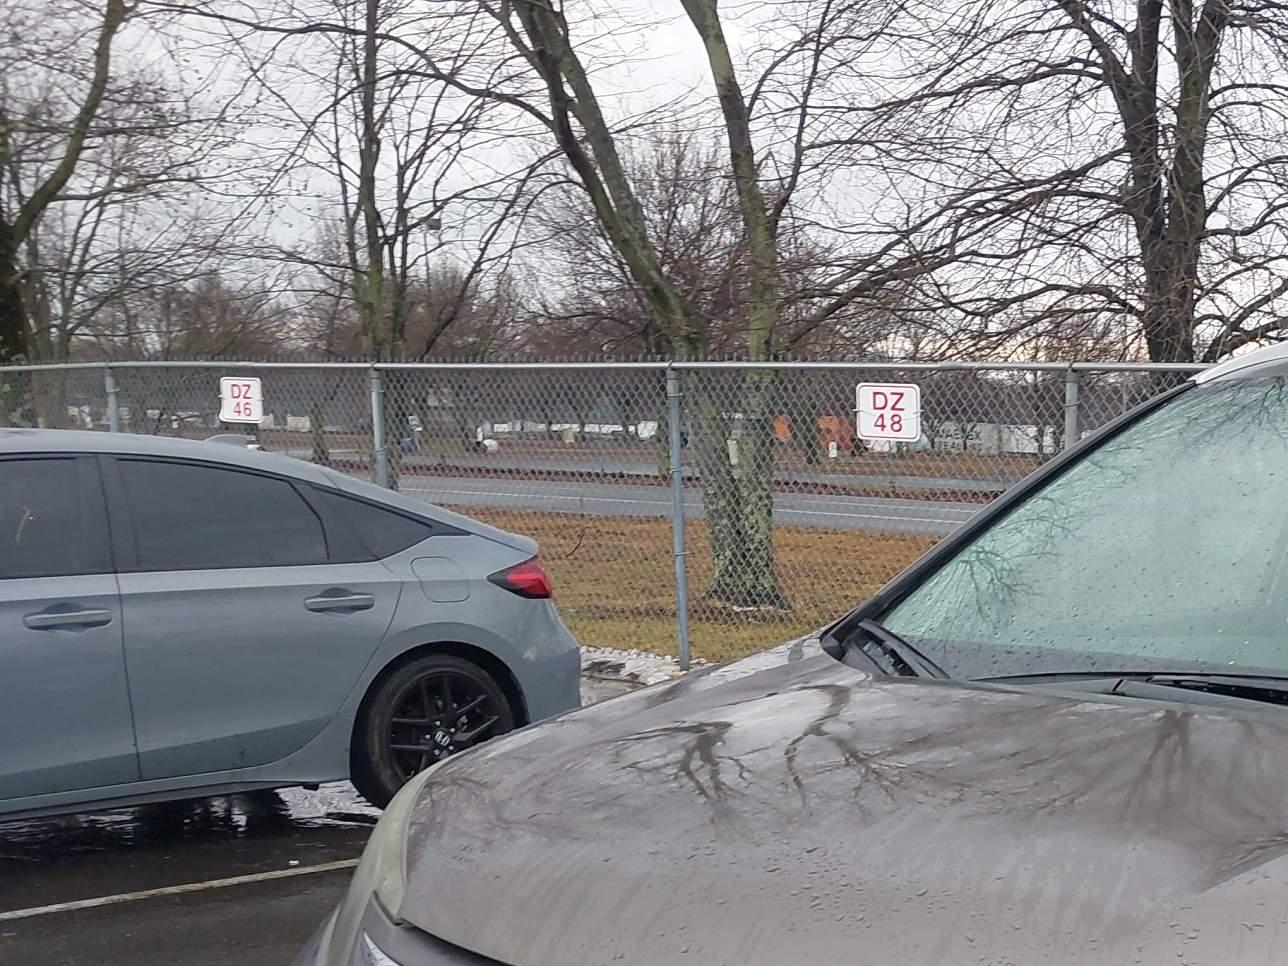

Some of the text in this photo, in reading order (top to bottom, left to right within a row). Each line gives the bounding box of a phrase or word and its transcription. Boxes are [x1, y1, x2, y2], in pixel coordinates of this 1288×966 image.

[231, 384, 252, 399] DZ
[233, 402, 252, 417] 46
[872, 392, 905, 411] DZ
[874, 413, 903, 433] 48
